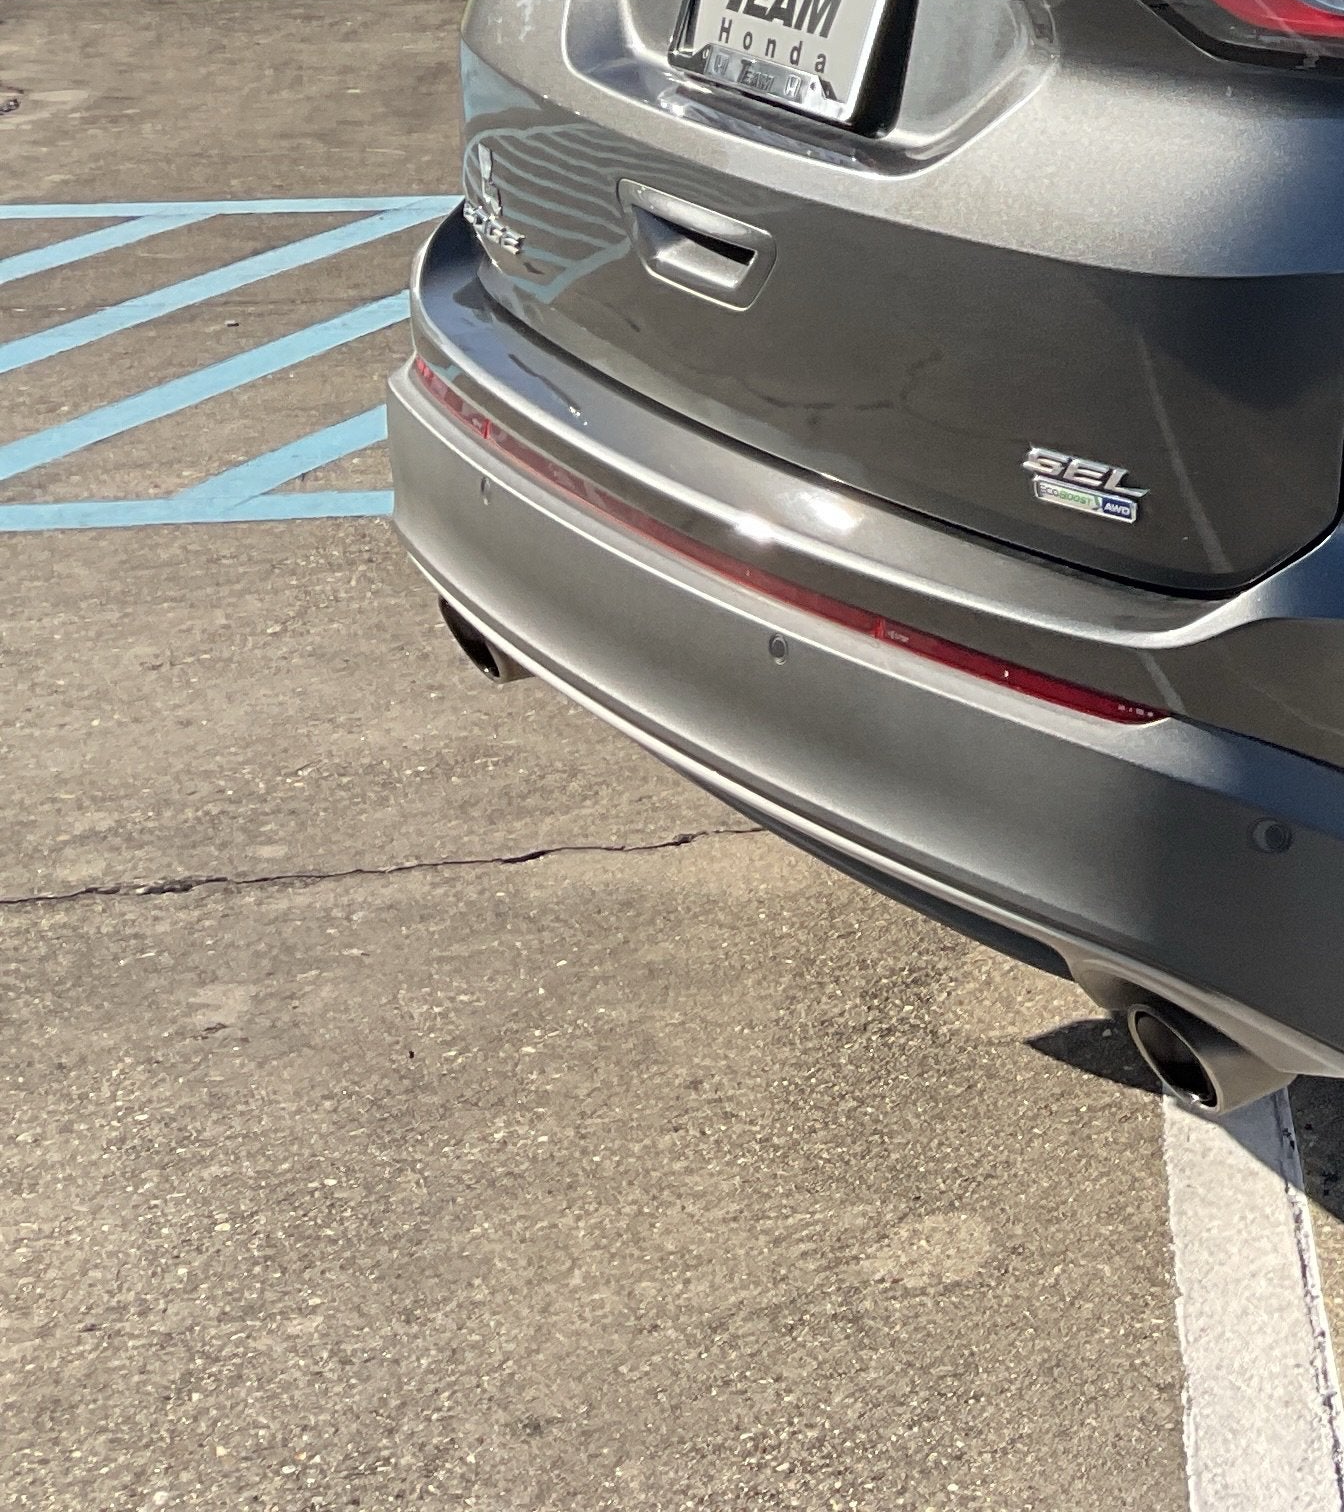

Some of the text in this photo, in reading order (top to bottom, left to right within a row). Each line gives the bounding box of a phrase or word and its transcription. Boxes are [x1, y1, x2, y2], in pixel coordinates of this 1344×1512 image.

[717, 16, 828, 75] Honda
[1022, 447, 1151, 498] SEL
[1103, 502, 1131, 516] AWD
